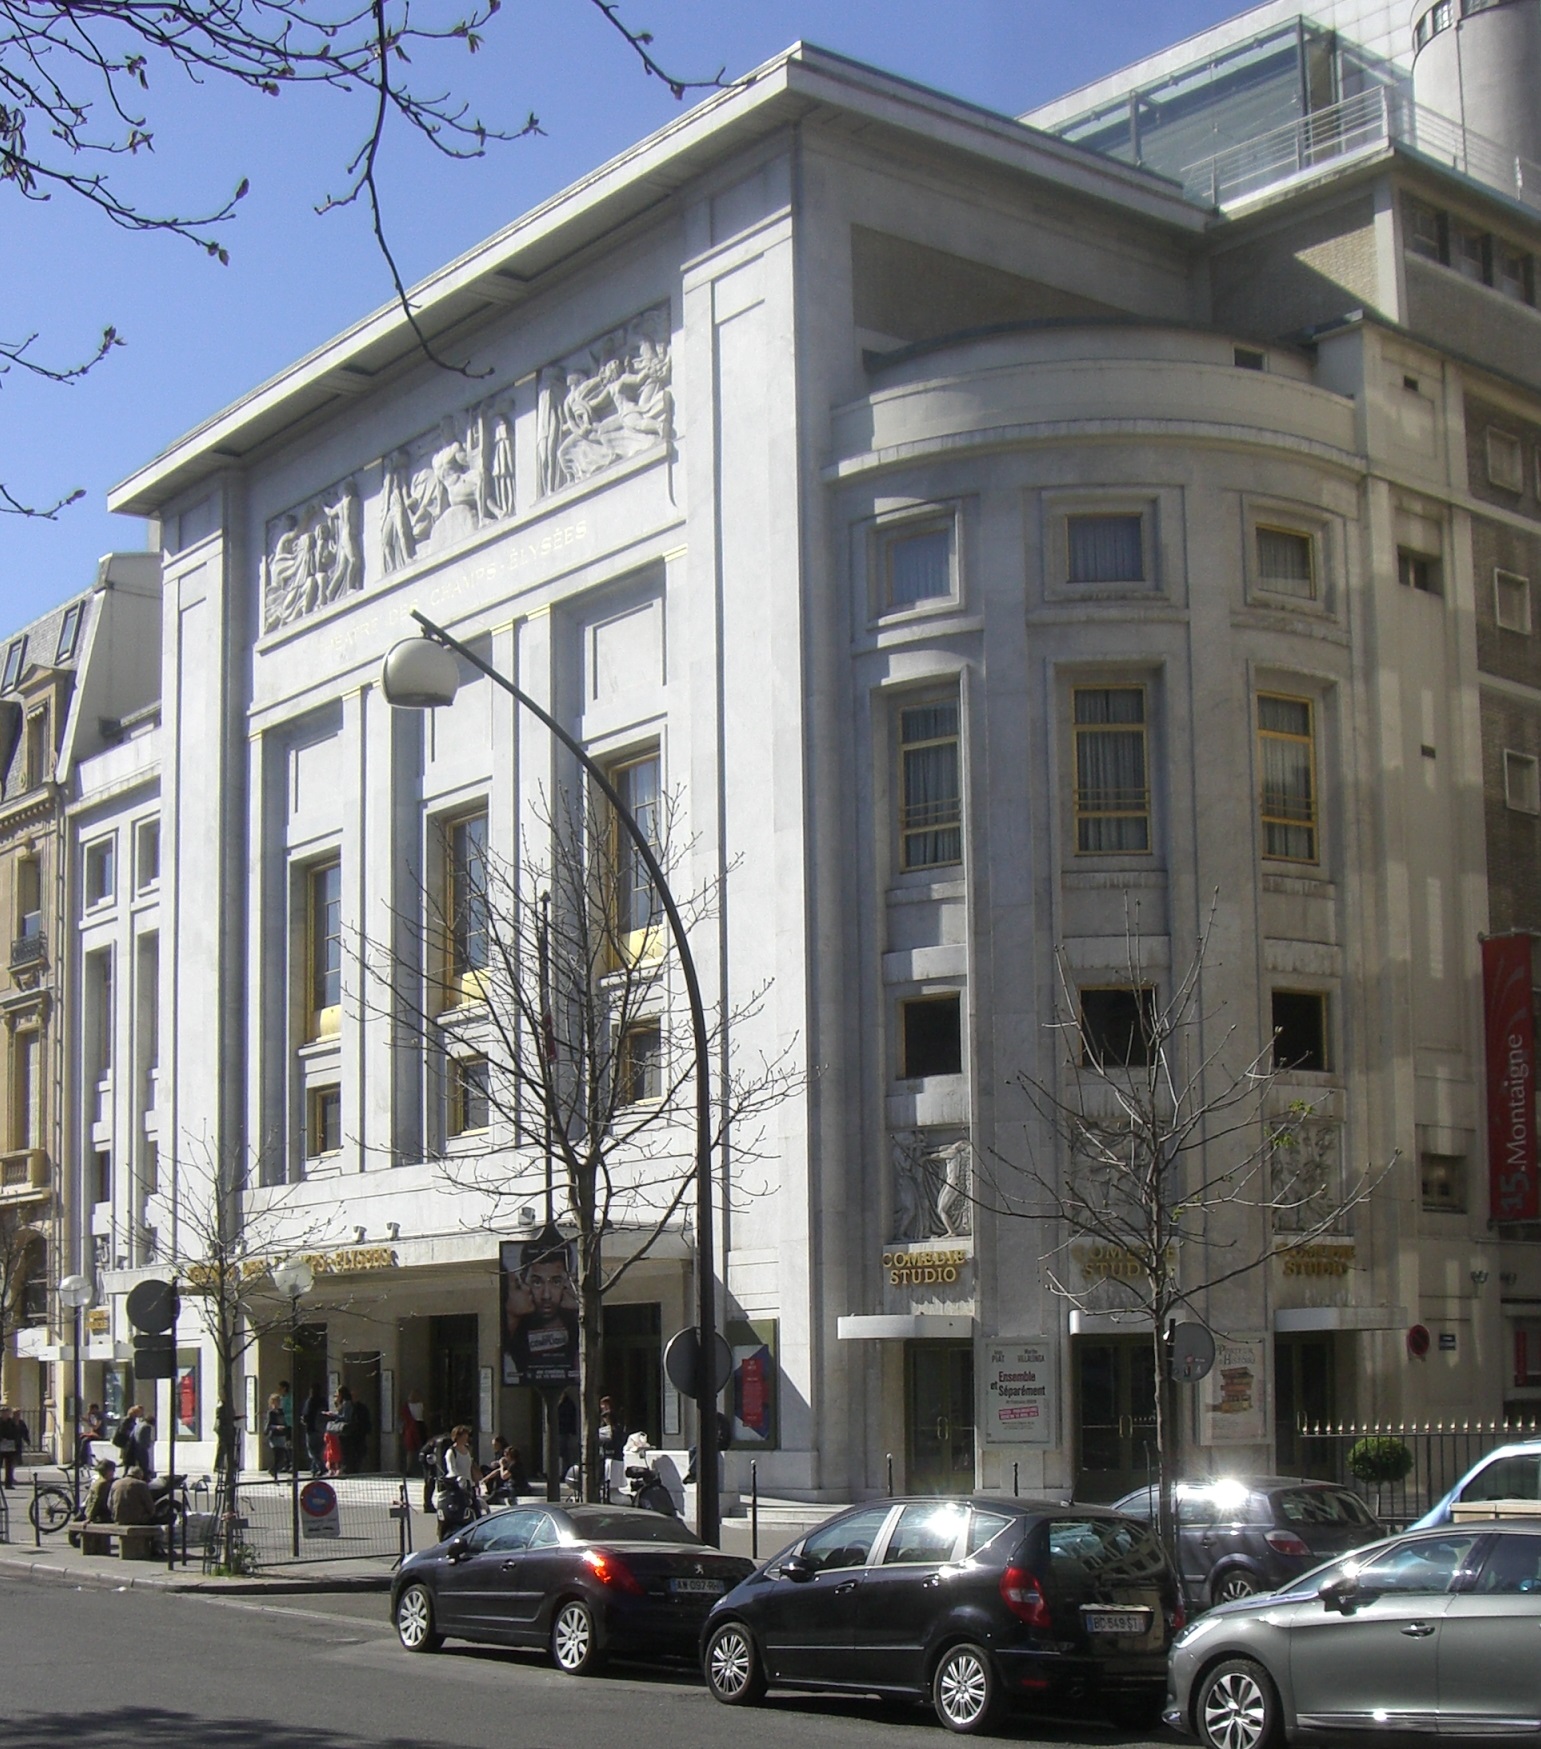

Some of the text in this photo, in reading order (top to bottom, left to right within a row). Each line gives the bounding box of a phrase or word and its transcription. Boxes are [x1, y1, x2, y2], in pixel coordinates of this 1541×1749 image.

[889, 1266, 957, 1285] STUDIO
[998, 1371, 1036, 1383] Ensemble
[990, 1381, 998, 1390] et
[998, 1385, 1046, 1399] Séparément
